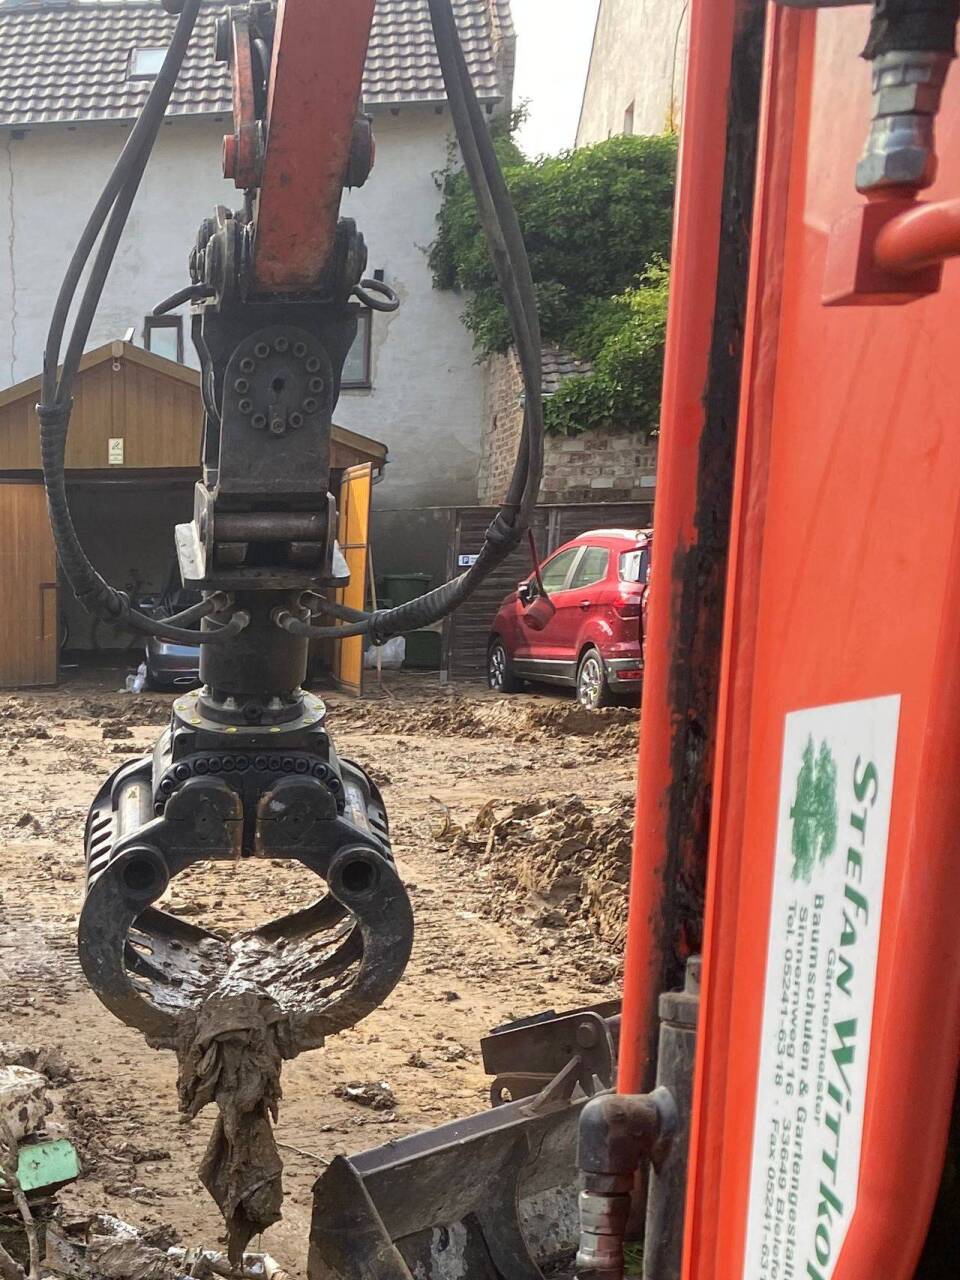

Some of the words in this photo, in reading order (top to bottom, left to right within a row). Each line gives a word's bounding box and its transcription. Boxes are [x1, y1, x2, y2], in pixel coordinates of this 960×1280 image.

[785, 906, 808, 1059] Sinnernweg
[800, 894, 824, 1071] Baumschulen
[814, 947, 836, 1126] Gärtnermeister
[785, 1070, 795, 1096] 16
[798, 1079, 809, 1097] &
[768, 1118, 780, 1160] Fax
[778, 1118, 792, 1190] 33649
